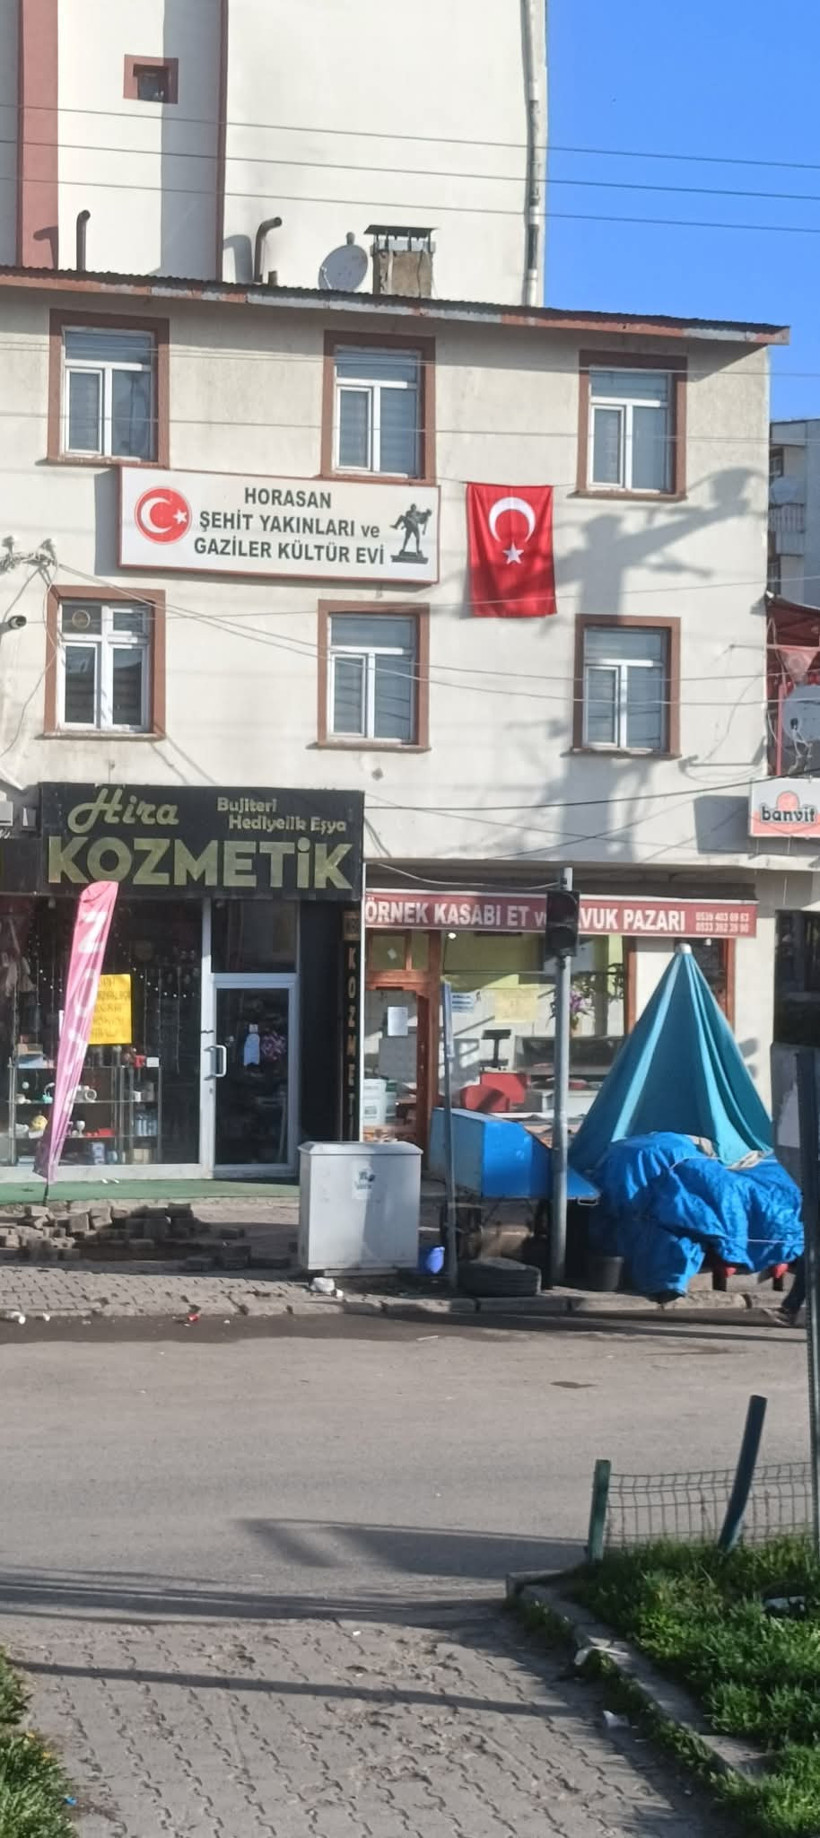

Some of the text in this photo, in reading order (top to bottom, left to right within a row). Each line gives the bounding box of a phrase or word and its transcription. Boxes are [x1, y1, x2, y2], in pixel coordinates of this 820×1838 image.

[244, 487, 331, 509] HORASAN
[199, 509, 380, 539] ŞEHİT YAKINLARI ve
[194, 536, 385, 565] GAZİLER KÜLTÜR EVİ
[67, 788, 180, 834] Hira
[228, 815, 347, 834] Hediyelik Eşya
[761, 806, 816, 822] banvit
[48, 837, 352, 889] KOZMETİK
[365, 897, 428, 924] ÖRNEK
[506, 906, 530, 928] ET
[623, 909, 685, 932] PAZARI
